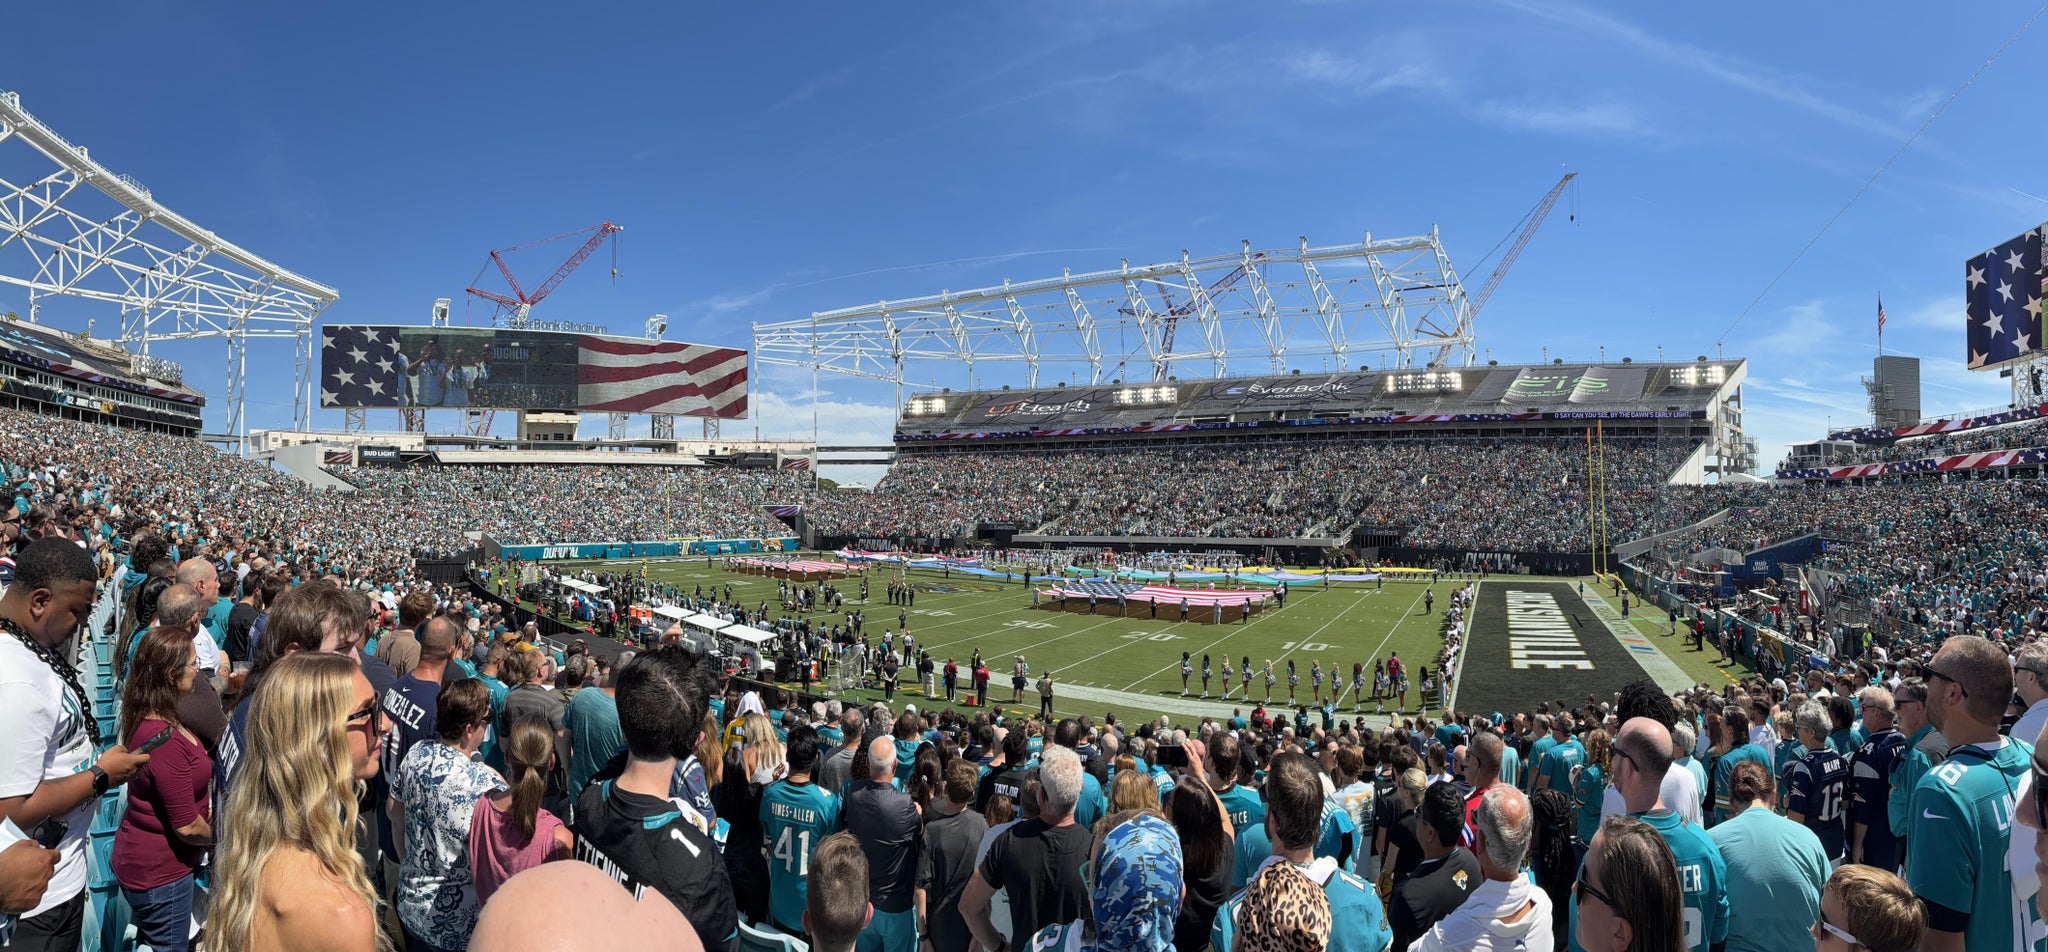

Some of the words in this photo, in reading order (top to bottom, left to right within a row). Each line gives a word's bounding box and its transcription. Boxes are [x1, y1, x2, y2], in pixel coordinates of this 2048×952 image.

[563, 320, 608, 334] Stadium
[1372, 528, 1399, 536] EverBank
[1120, 631, 1177, 642] 20
[1505, 590, 1596, 670] JACKSONVILLE
[1281, 641, 1329, 652] 10
[383, 687, 426, 730] GONZALEZ
[994, 783, 1019, 798] TAYLOR
[1818, 780, 1844, 821] 12
[771, 802, 815, 824] HINES-ALLEN
[670, 827, 701, 858] 1
[773, 826, 811, 877] 41
